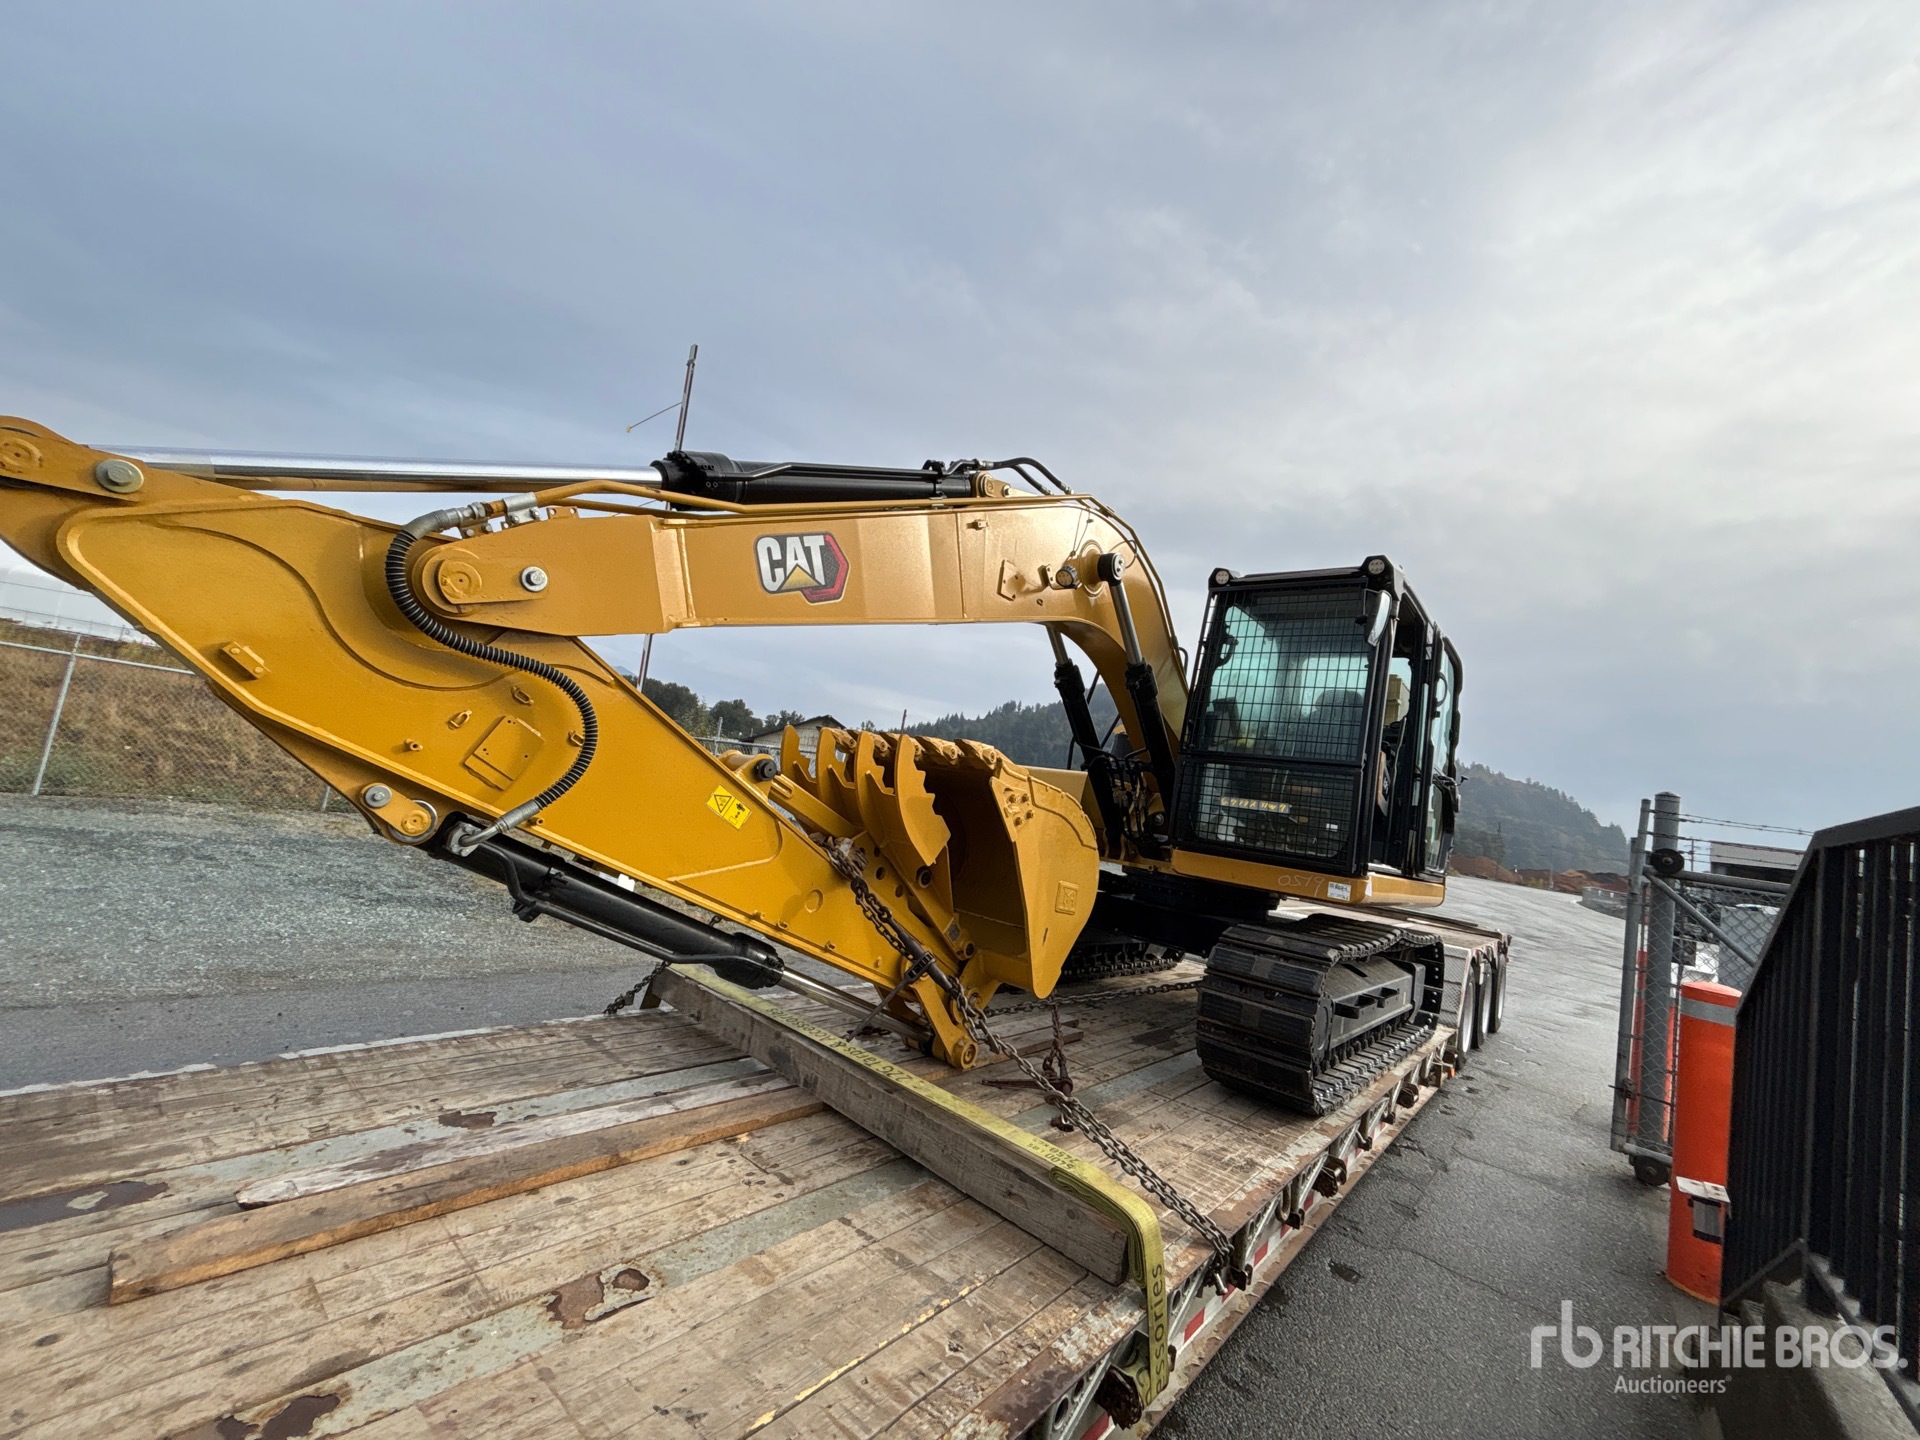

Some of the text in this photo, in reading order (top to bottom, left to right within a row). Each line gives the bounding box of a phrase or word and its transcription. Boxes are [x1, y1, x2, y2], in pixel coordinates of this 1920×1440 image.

[756, 534, 826, 591] CAT
[766, 1007, 838, 1042] Accessories
[843, 1046, 881, 1067] Tarps
